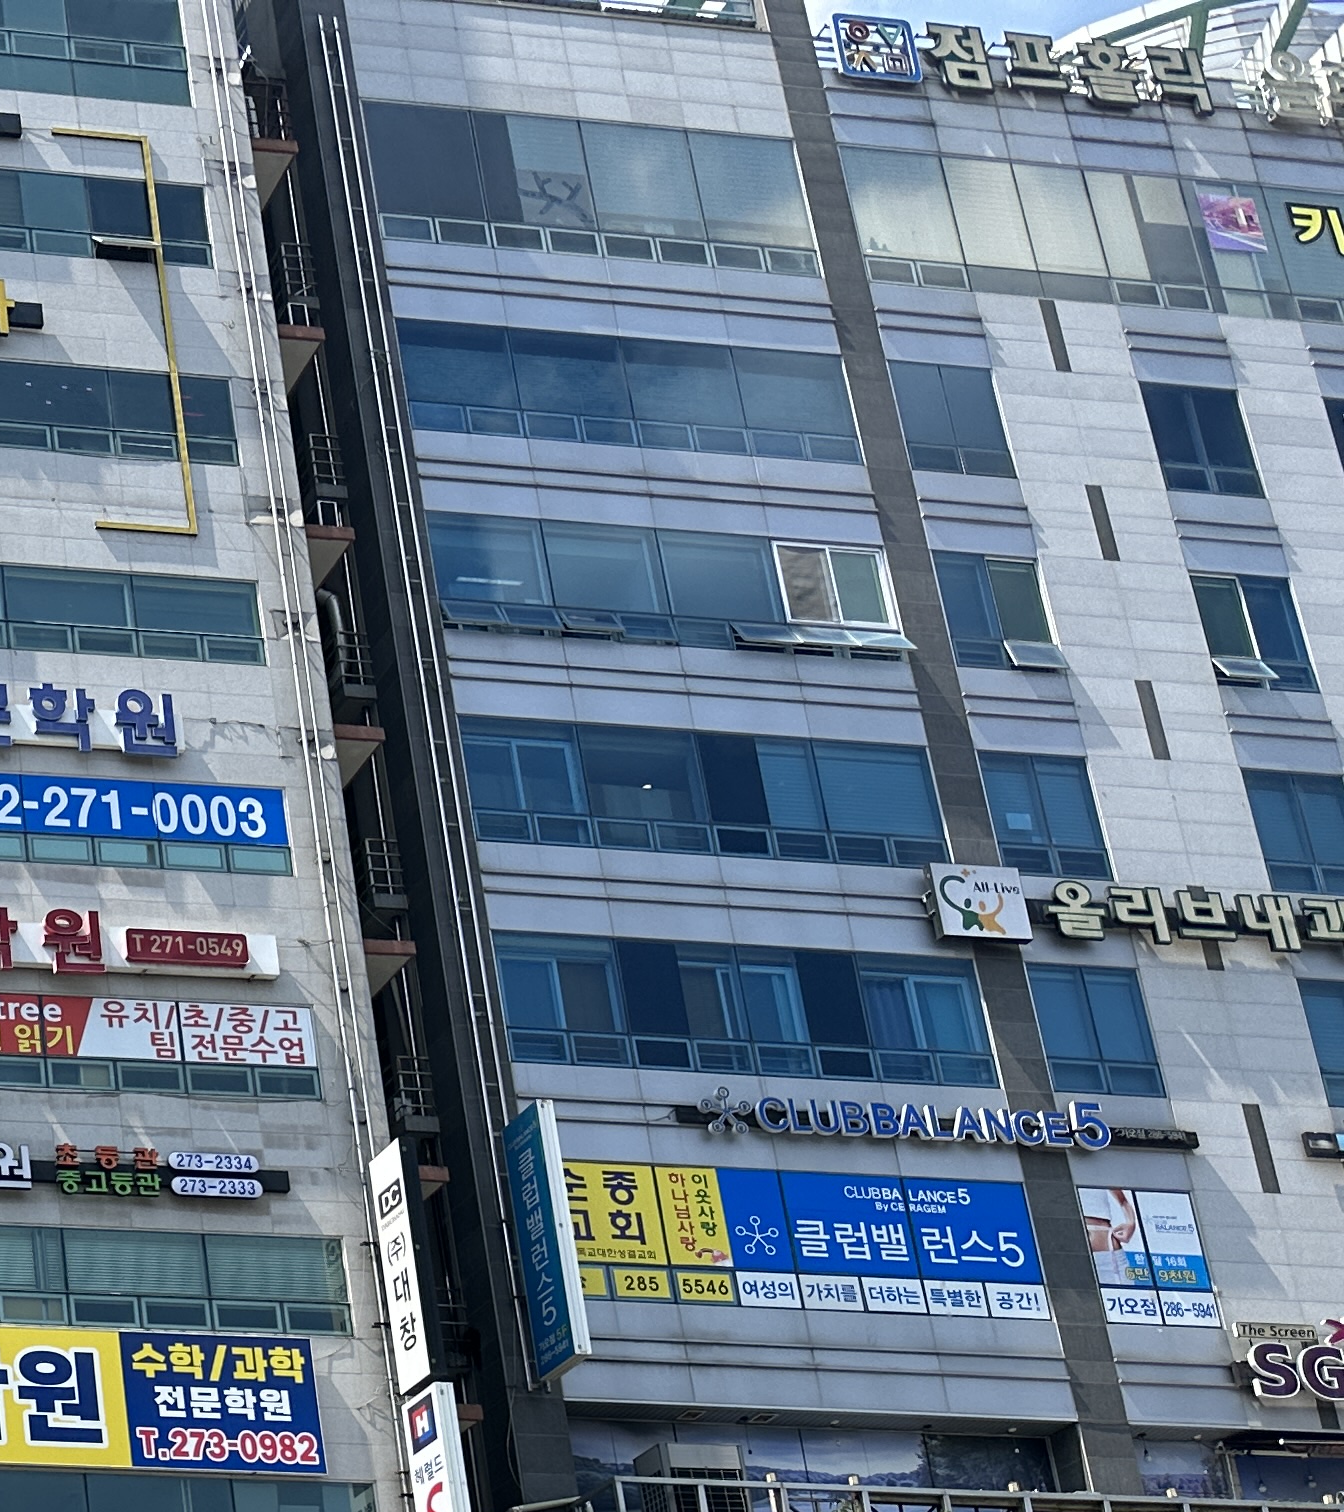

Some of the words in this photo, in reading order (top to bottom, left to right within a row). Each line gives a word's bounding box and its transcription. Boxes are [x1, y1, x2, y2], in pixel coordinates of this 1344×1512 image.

[924, 21, 1215, 118] 점프홀릭
[972, 880, 1021, 896] All-Live
[150, 934, 244, 958] 271-0549
[13, 1022, 74, 1056] 읽기
[150, 1031, 178, 1060] 팀
[190, 1034, 306, 1066] 전문수업
[55, 1143, 159, 1171] 초등관
[175, 1153, 253, 1172] 273-2334
[55, 1170, 162, 1198] 중고등관
[179, 1176, 257, 1196] 273-2333
[380, 1183, 402, 1213] DC
[668, 1171, 697, 1252] 하나님사랑
[691, 1173, 718, 1238] 이웃사랑
[624, 1275, 660, 1292] 285
[682, 1278, 729, 1296] 5546
[741, 1279, 796, 1301] 여성의
[805, 1283, 858, 1304] 가치를
[868, 1285, 922, 1306] 더하는
[929, 1288, 982, 1309] 특별한
[996, 1290, 1040, 1313] 공간!
[1106, 1296, 1157, 1317] 가오점
[1241, 1323, 1265, 1337] The
[1270, 1325, 1315, 1338] Screen
[132, 1341, 306, 1385] 수학/과학
[153, 1385, 293, 1422] 전문학원
